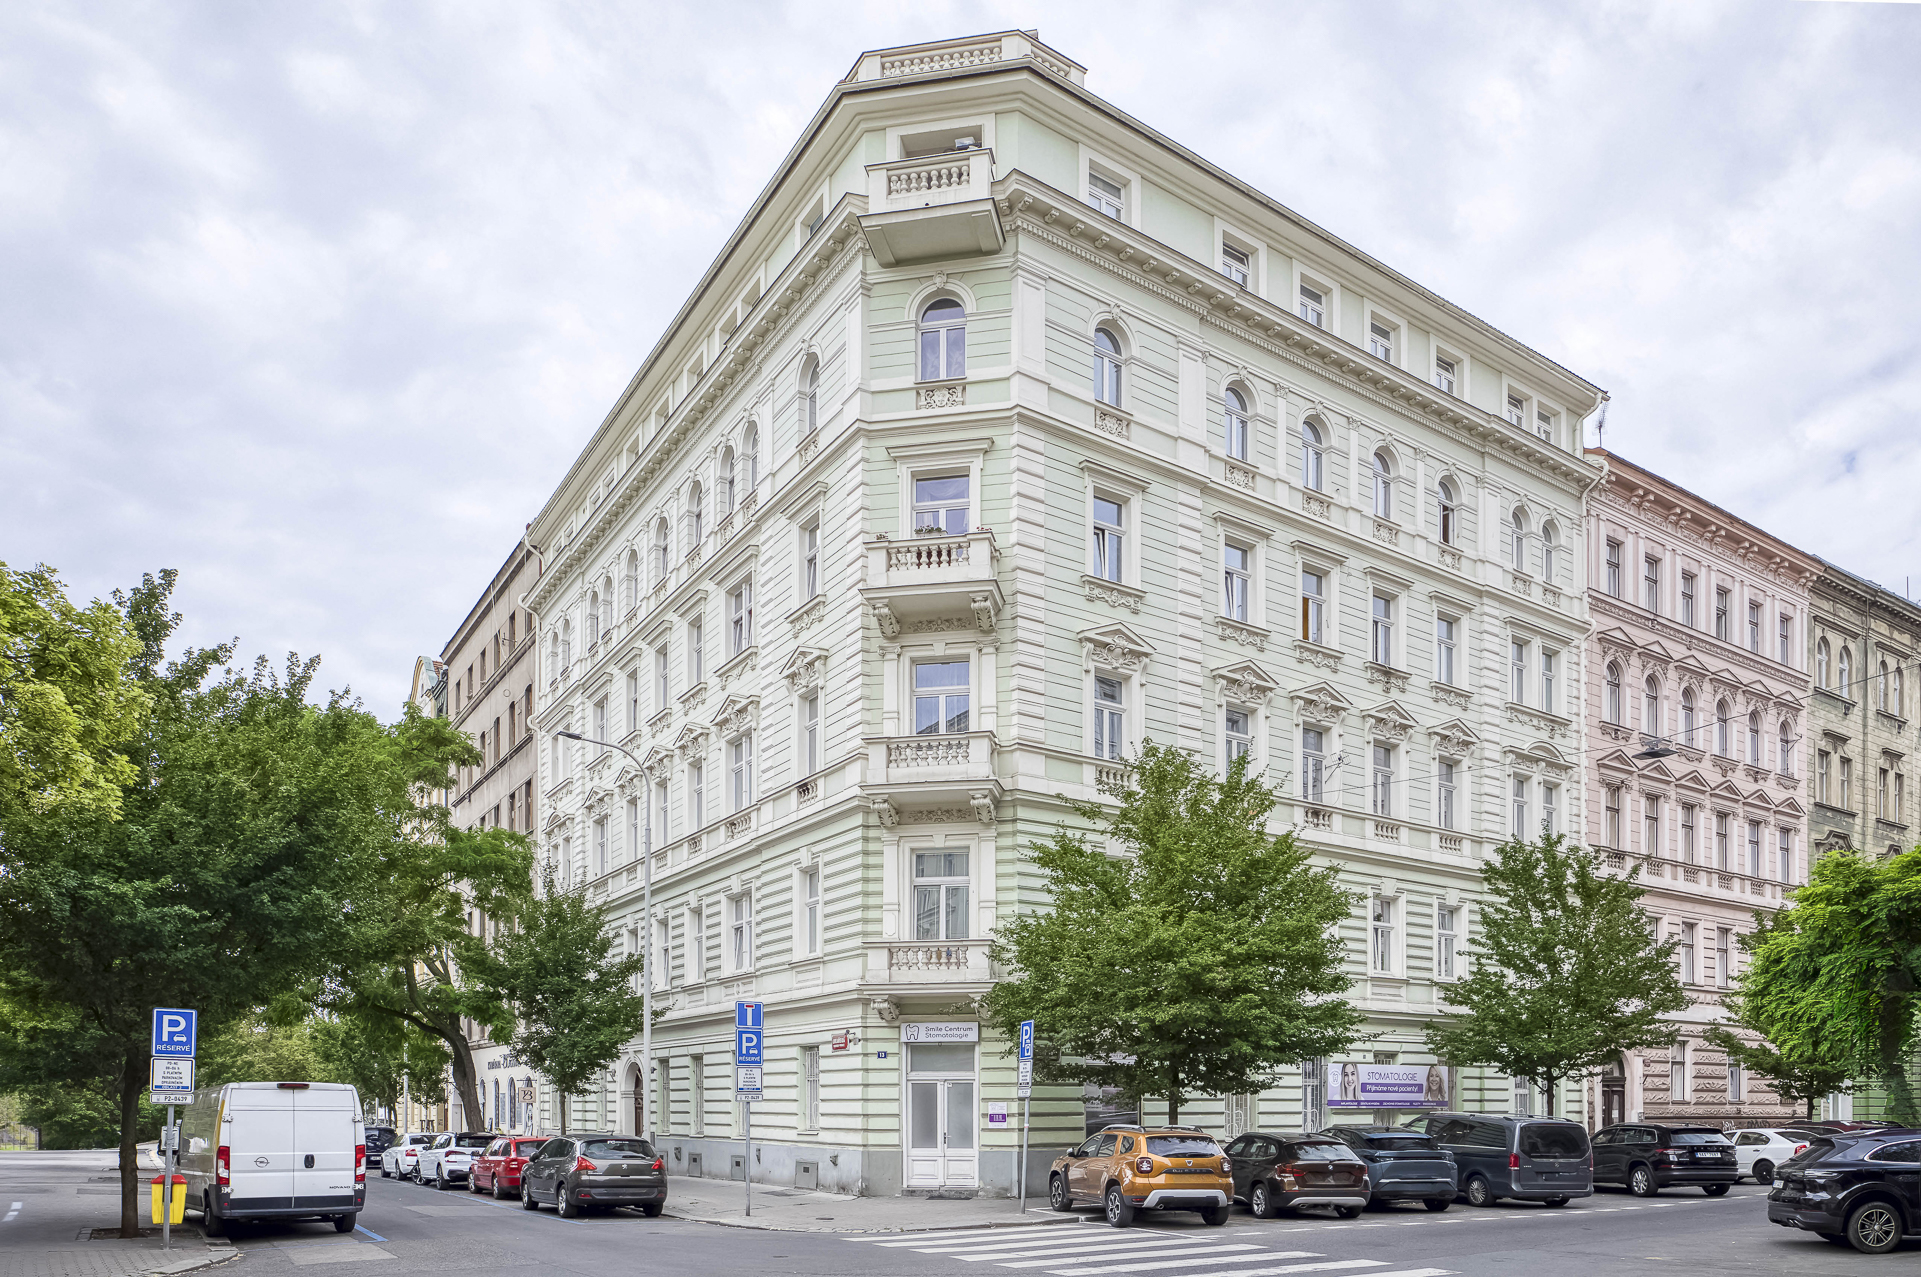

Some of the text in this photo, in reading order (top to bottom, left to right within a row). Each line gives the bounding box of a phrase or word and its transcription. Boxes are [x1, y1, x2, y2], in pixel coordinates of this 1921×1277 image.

[162, 1014, 186, 1042] P
[1022, 1026, 1030, 1048] P
[156, 1044, 191, 1052] RÉSERVÉ
[742, 1033, 758, 1055] P
[1367, 1071, 1418, 1082] STOMATOLOGIE
